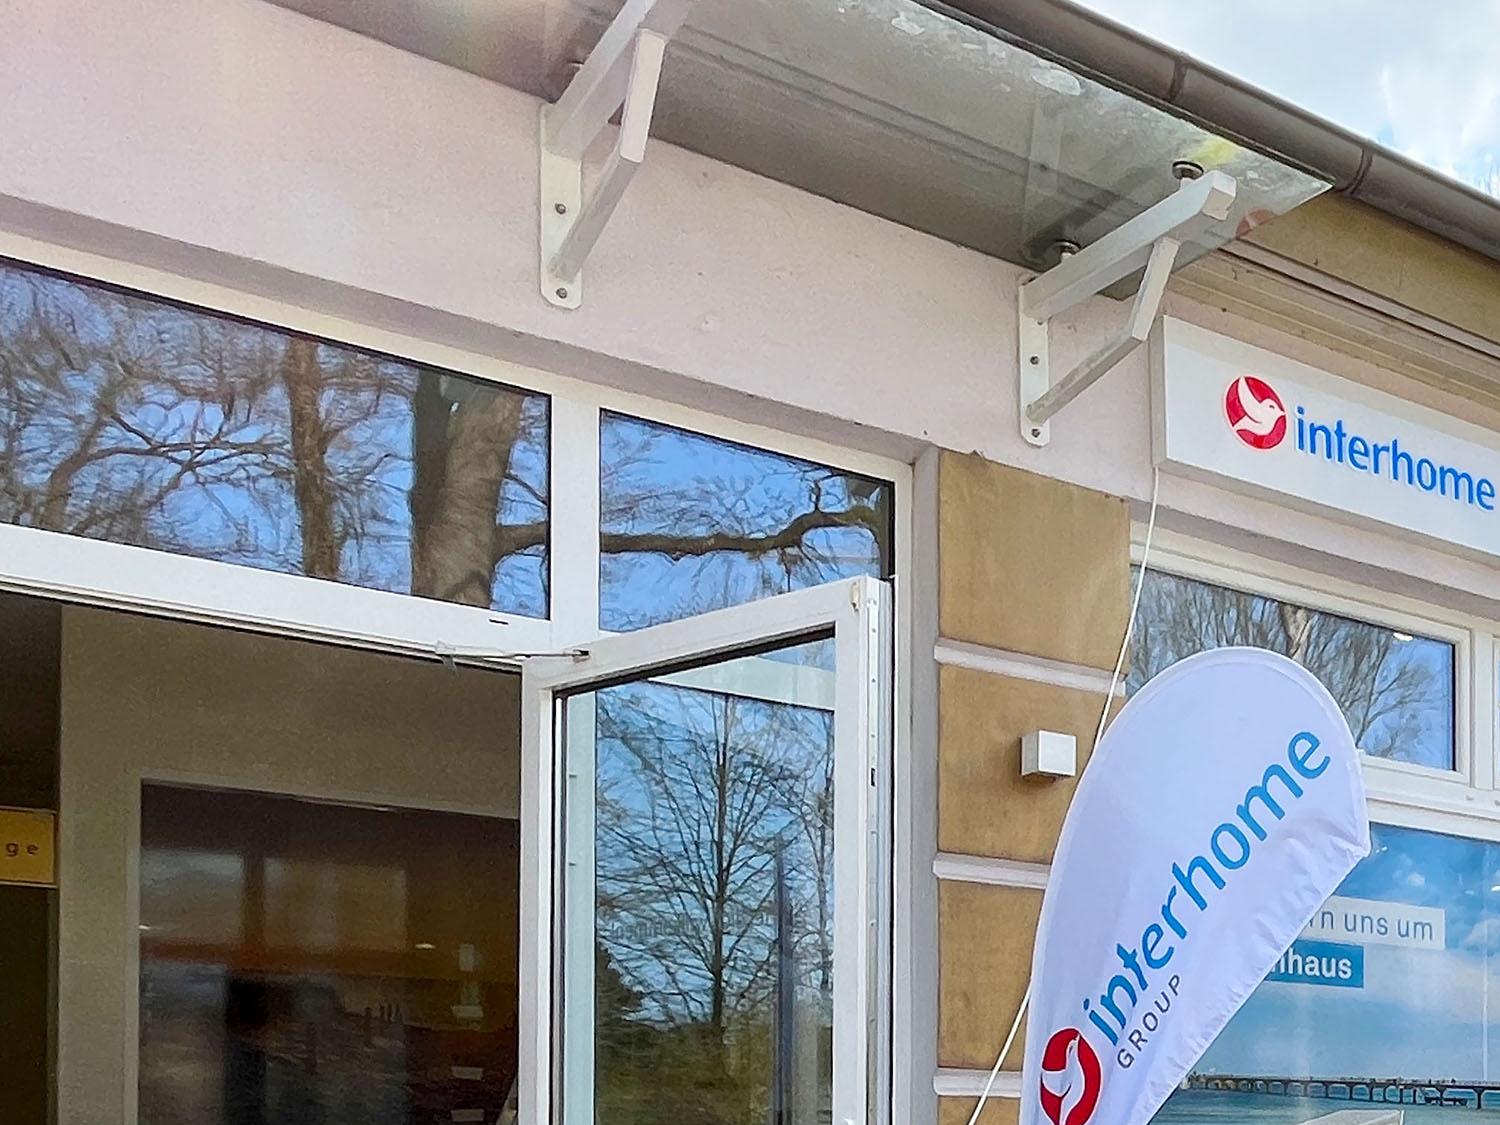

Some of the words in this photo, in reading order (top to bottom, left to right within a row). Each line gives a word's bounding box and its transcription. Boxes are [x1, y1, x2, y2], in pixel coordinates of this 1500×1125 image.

[1295, 407, 1496, 511] interhome
[1083, 731, 1332, 1047] interhome
[1344, 913, 1389, 936] uns
[1397, 919, 1433, 941] um
[1116, 973, 1182, 1069] GROUP
